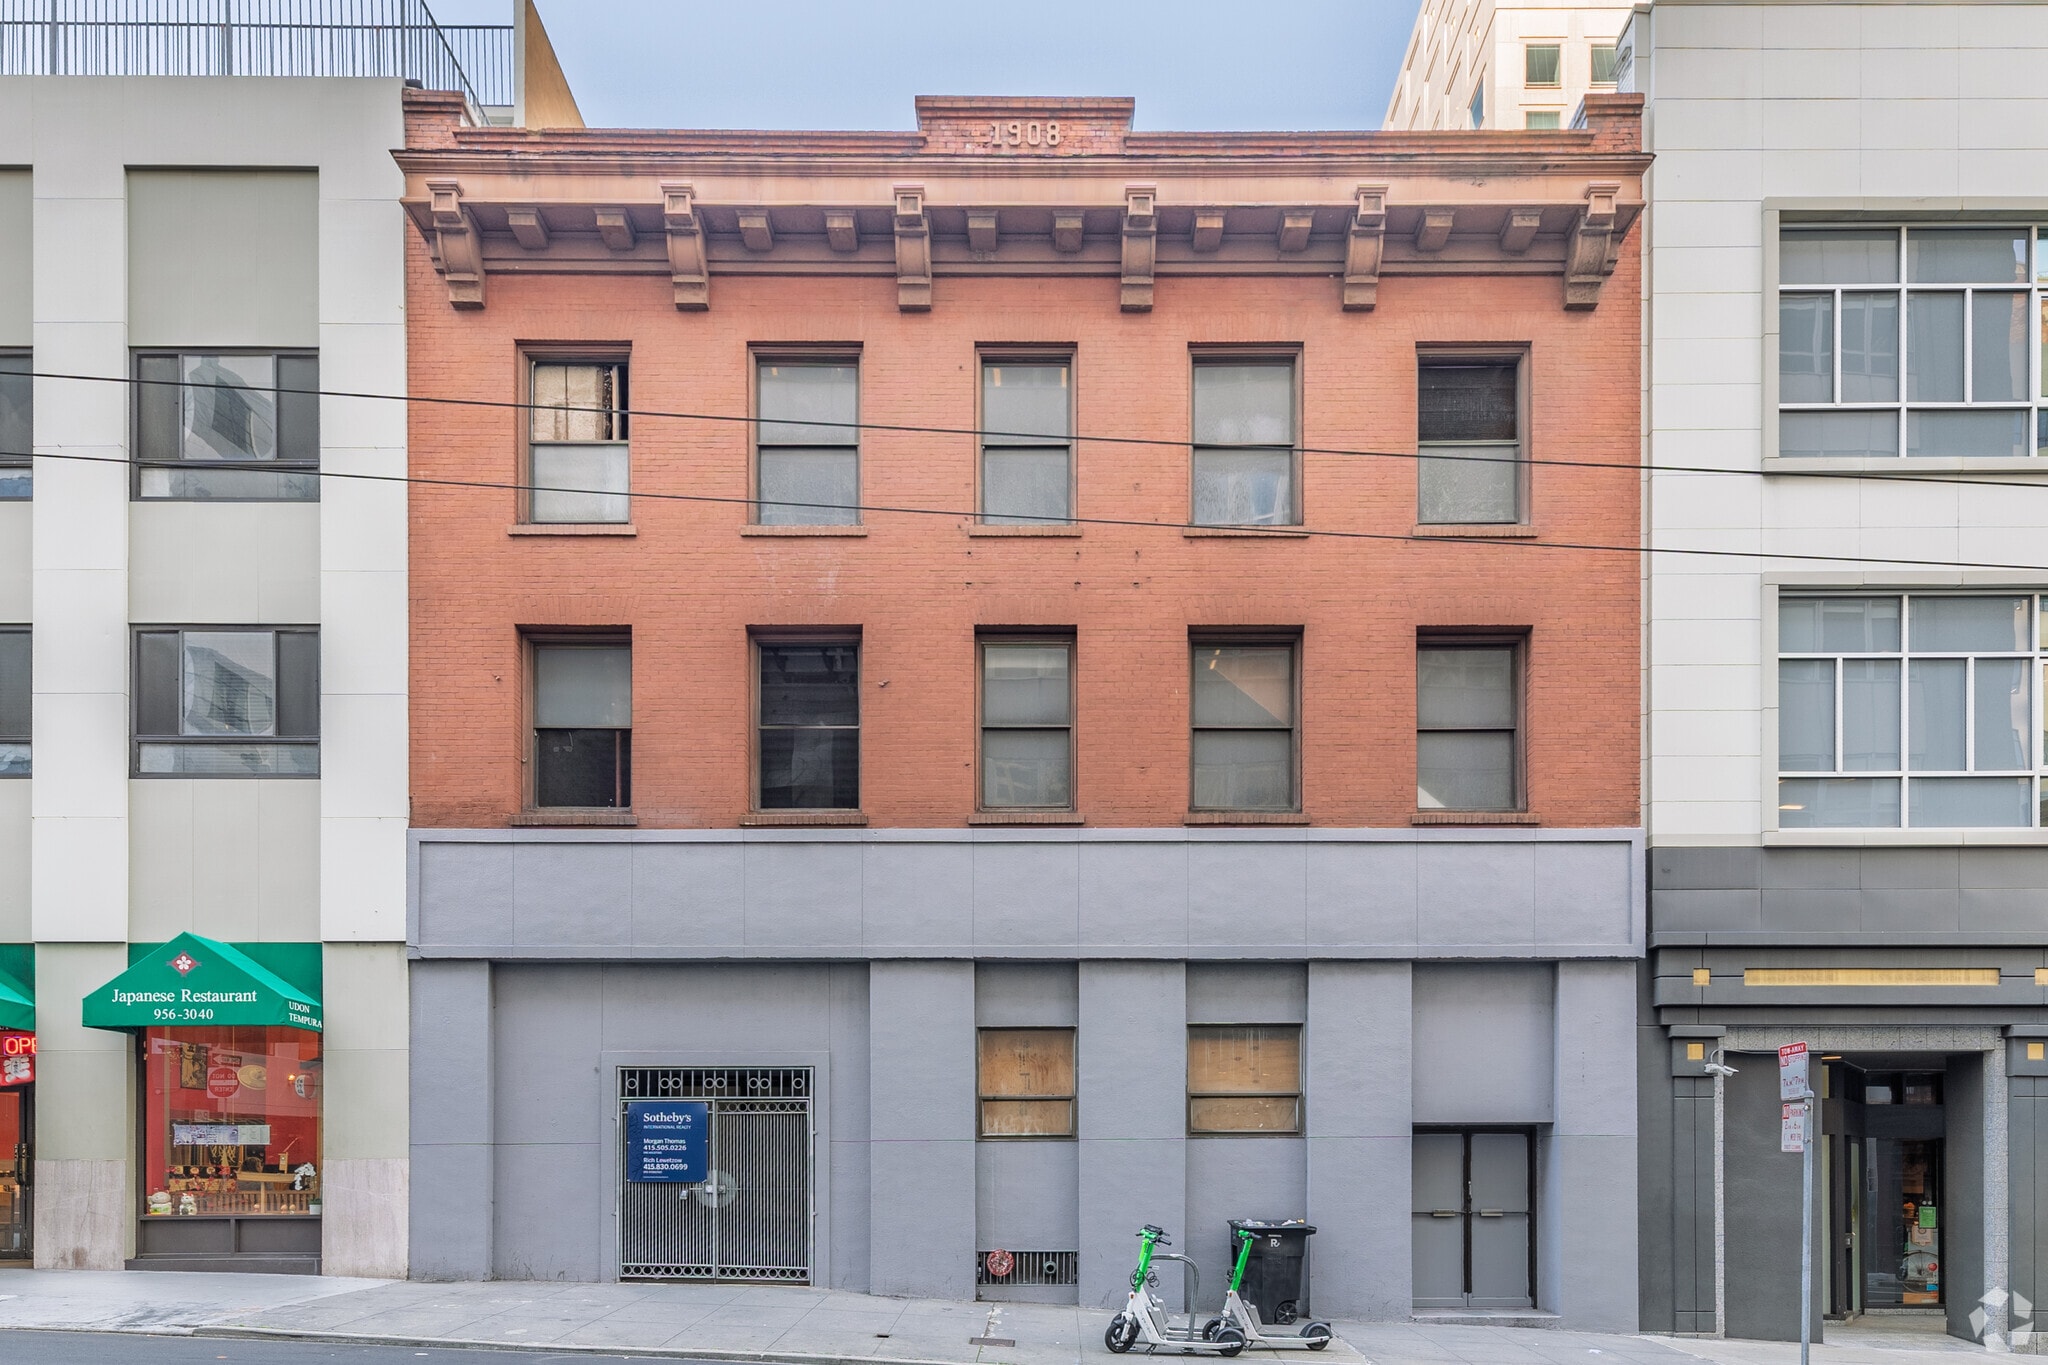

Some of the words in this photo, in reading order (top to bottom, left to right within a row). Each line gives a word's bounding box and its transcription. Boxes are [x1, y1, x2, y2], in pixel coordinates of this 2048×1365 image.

[990, 120, 1061, 147] 1908
[111, 989, 175, 1006] Japanese
[181, 988, 257, 1002] Restaurant
[153, 1008, 214, 1020] 956-3040
[288, 1001, 310, 1014] UDON
[288, 1013, 322, 1028] TEMPURA
[643, 1112, 692, 1124] Sotheby's
